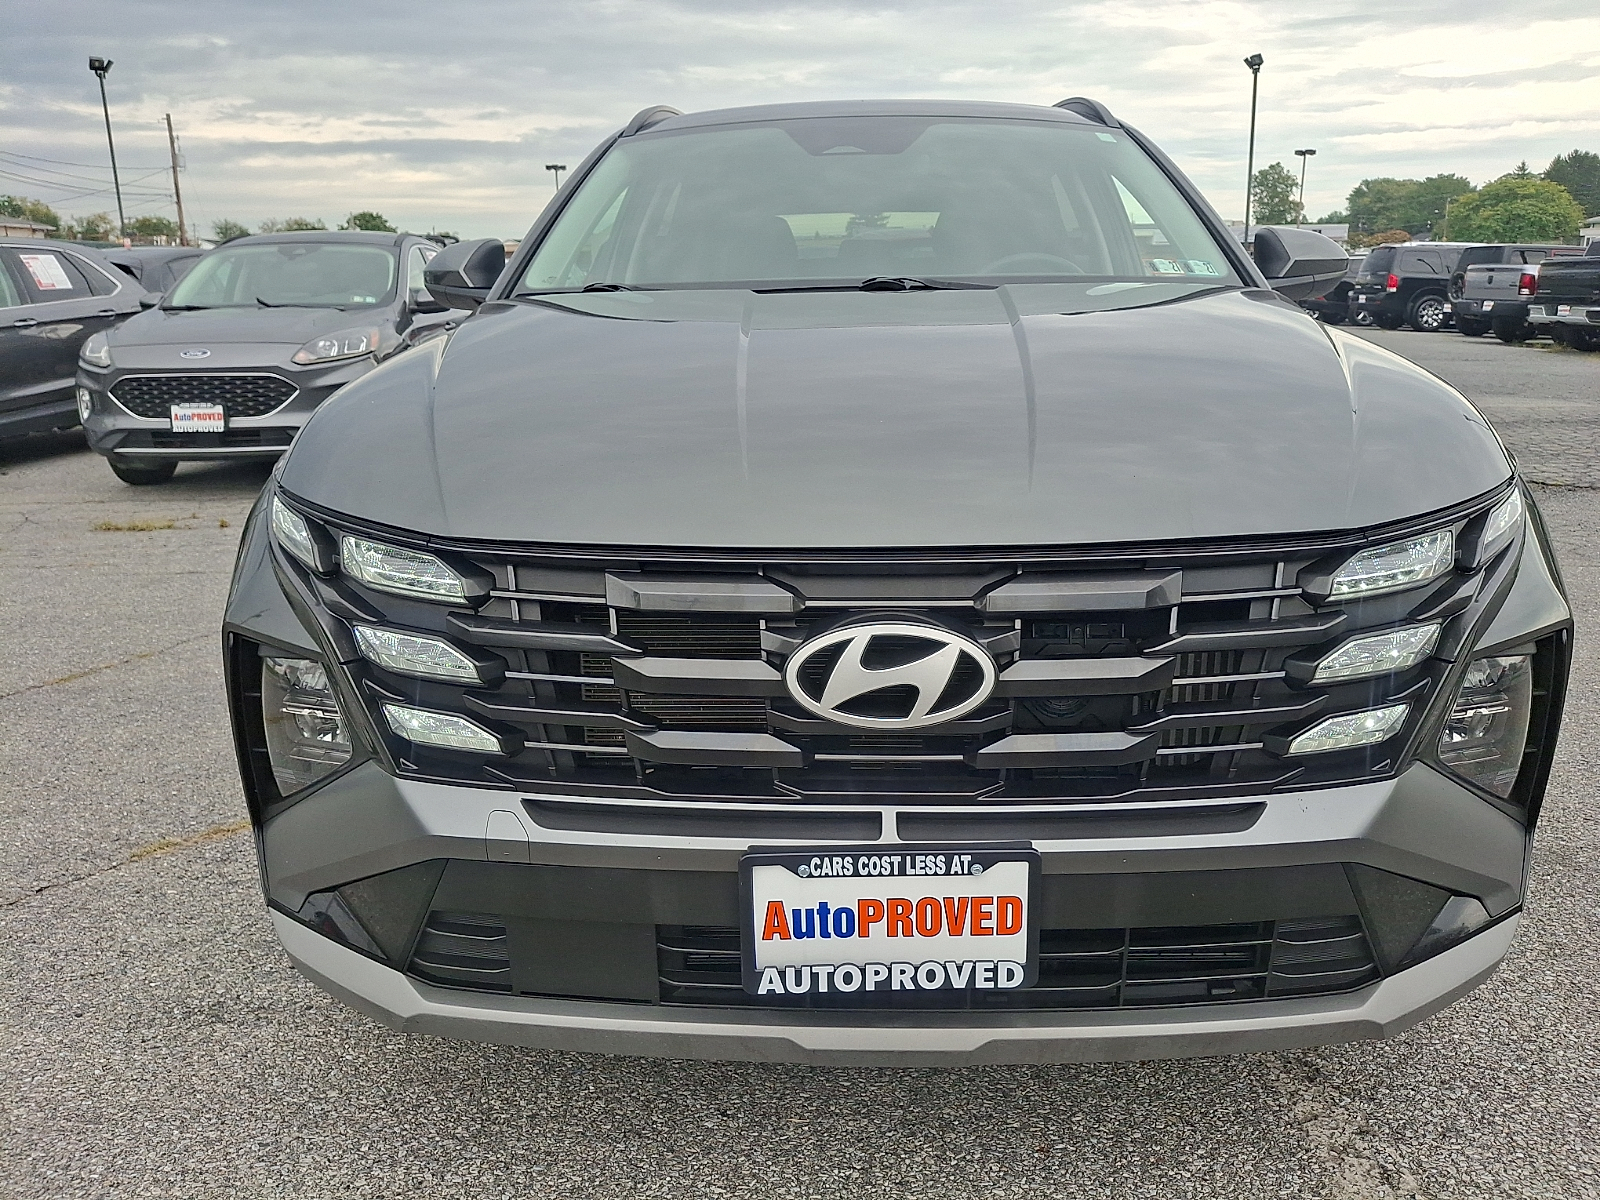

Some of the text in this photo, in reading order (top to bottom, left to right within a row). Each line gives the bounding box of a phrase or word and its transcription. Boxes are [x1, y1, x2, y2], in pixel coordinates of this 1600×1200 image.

[174, 413, 223, 421] AutoPROVED
[810, 855, 971, 877] CARS COST LESS AT
[762, 896, 1024, 941] AutoPROVED
[757, 961, 1025, 995] AUTOPROVED
